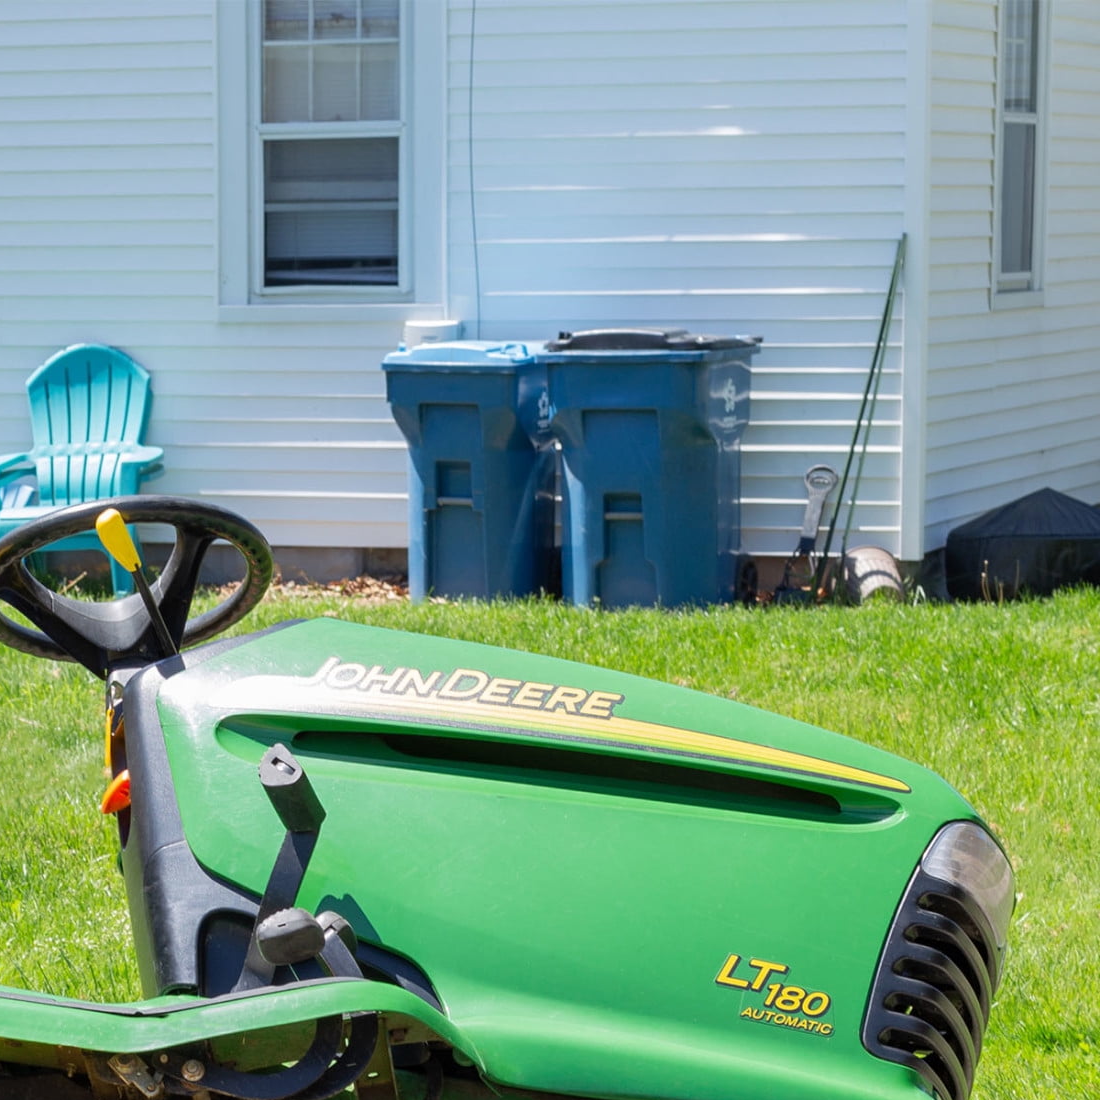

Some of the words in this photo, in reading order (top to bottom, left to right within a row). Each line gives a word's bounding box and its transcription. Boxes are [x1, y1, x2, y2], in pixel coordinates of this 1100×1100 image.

[302, 655, 442, 699] JOHN
[436, 667, 626, 720] DEERE
[715, 953, 790, 993] LT
[763, 983, 832, 1018] 180
[740, 1006, 834, 1036] AUTOMATIC
